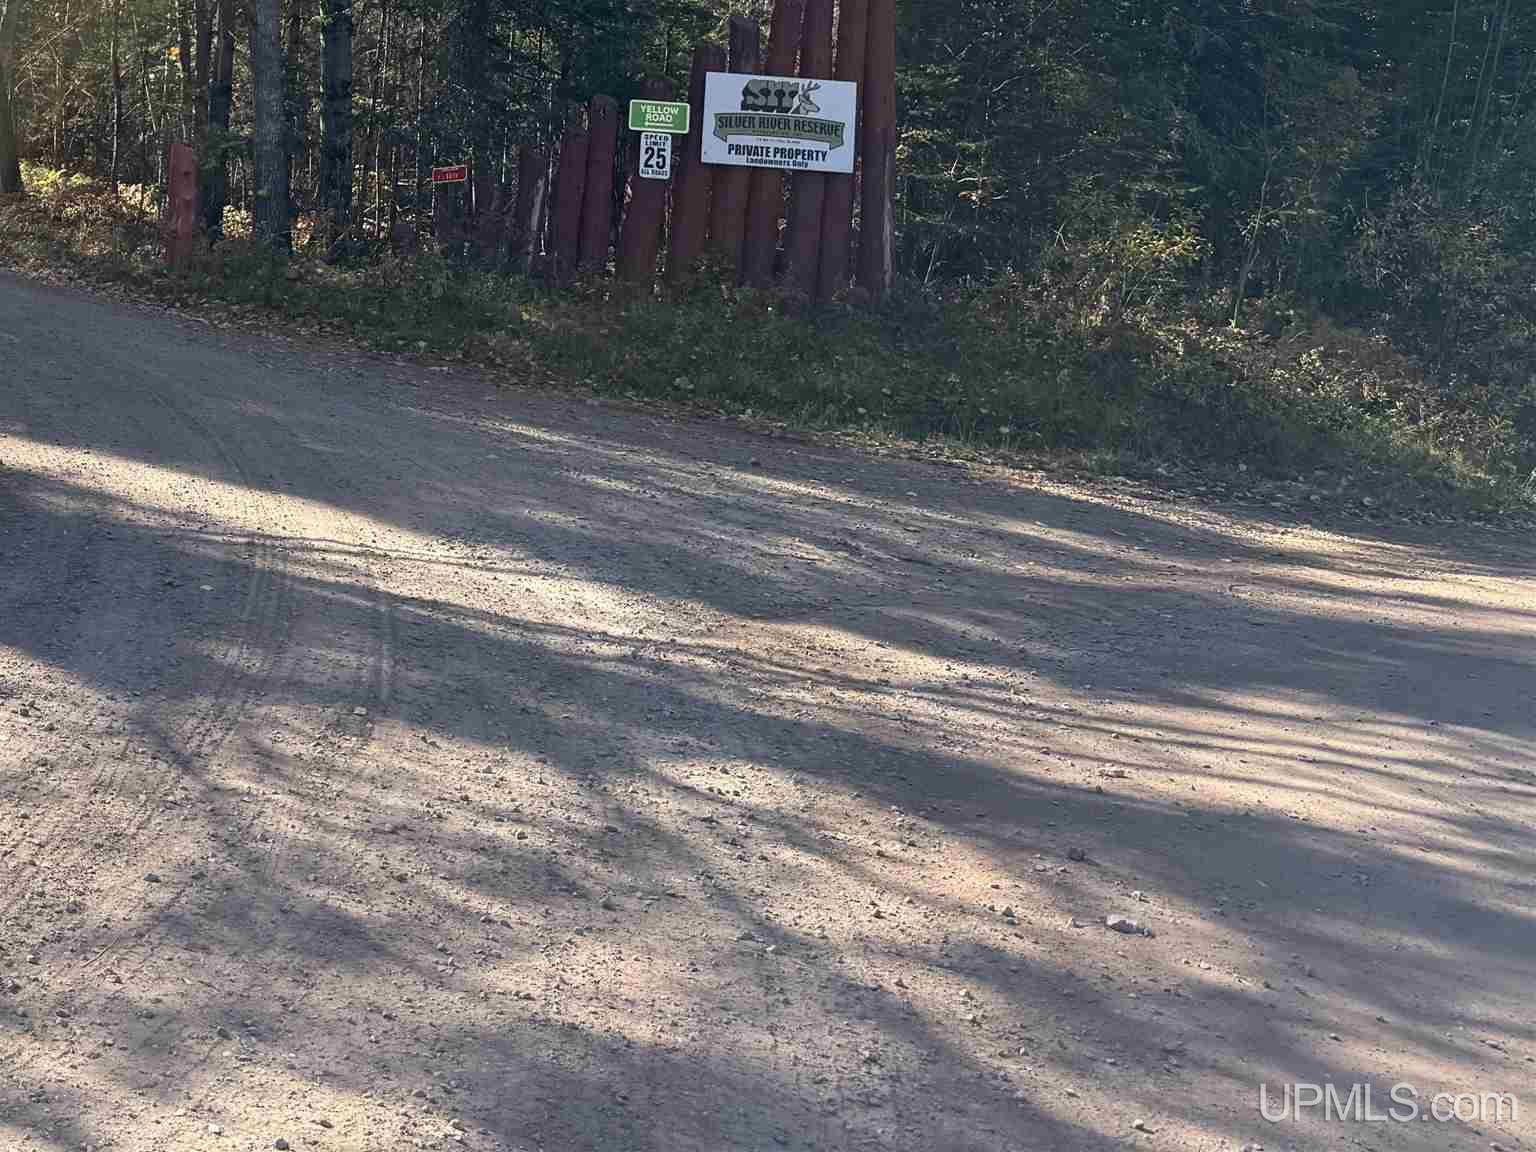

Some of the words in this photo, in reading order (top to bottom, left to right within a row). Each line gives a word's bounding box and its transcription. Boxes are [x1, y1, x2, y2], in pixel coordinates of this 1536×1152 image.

[640, 103, 679, 115] YELLOW
[645, 113, 673, 123] ROAD
[718, 115, 756, 129] SILVER
[758, 116, 792, 131] RIVER
[795, 119, 842, 138] RESERVE
[644, 134, 670, 142] SPEED
[643, 146, 667, 170] 25
[727, 143, 771, 158] PRIVATE
[773, 147, 828, 162] PROPERTY
